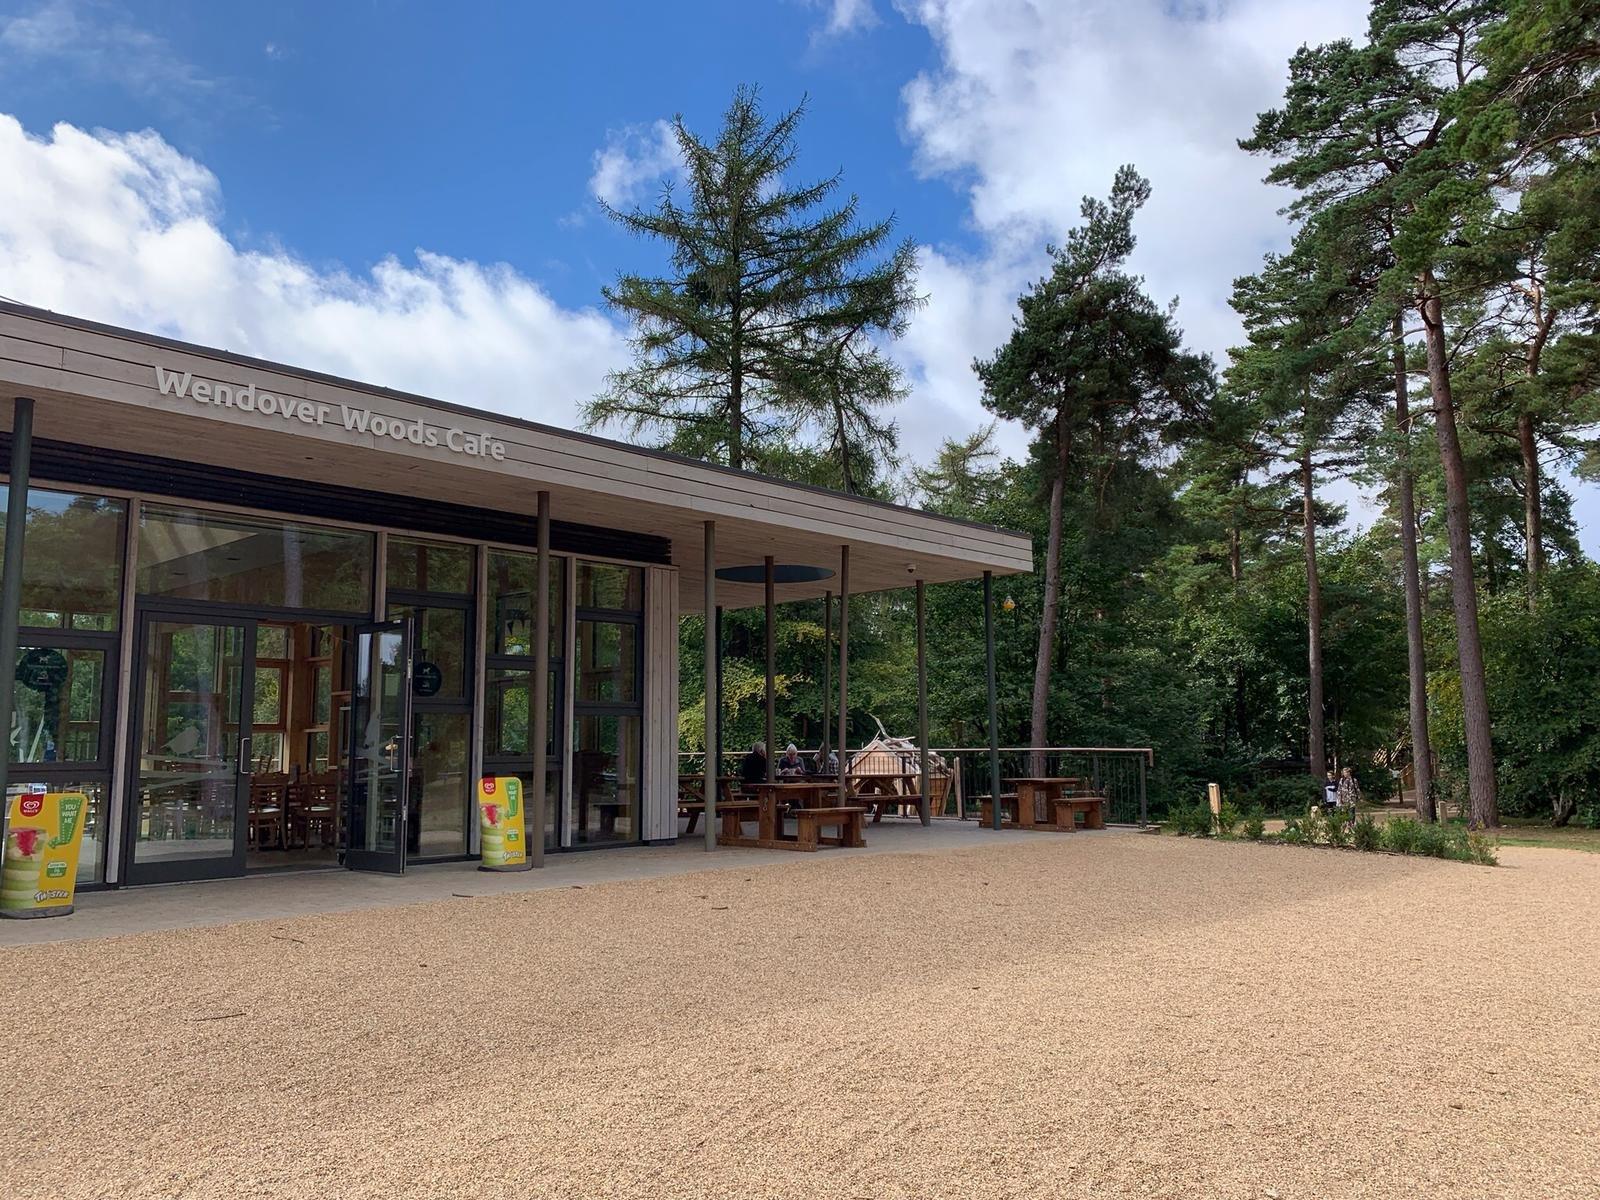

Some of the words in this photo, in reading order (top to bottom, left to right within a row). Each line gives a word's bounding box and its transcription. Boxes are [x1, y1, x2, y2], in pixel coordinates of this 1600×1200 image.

[154, 366, 331, 426] Wendover
[340, 404, 439, 448] Woods
[445, 427, 506, 461] Cafe
